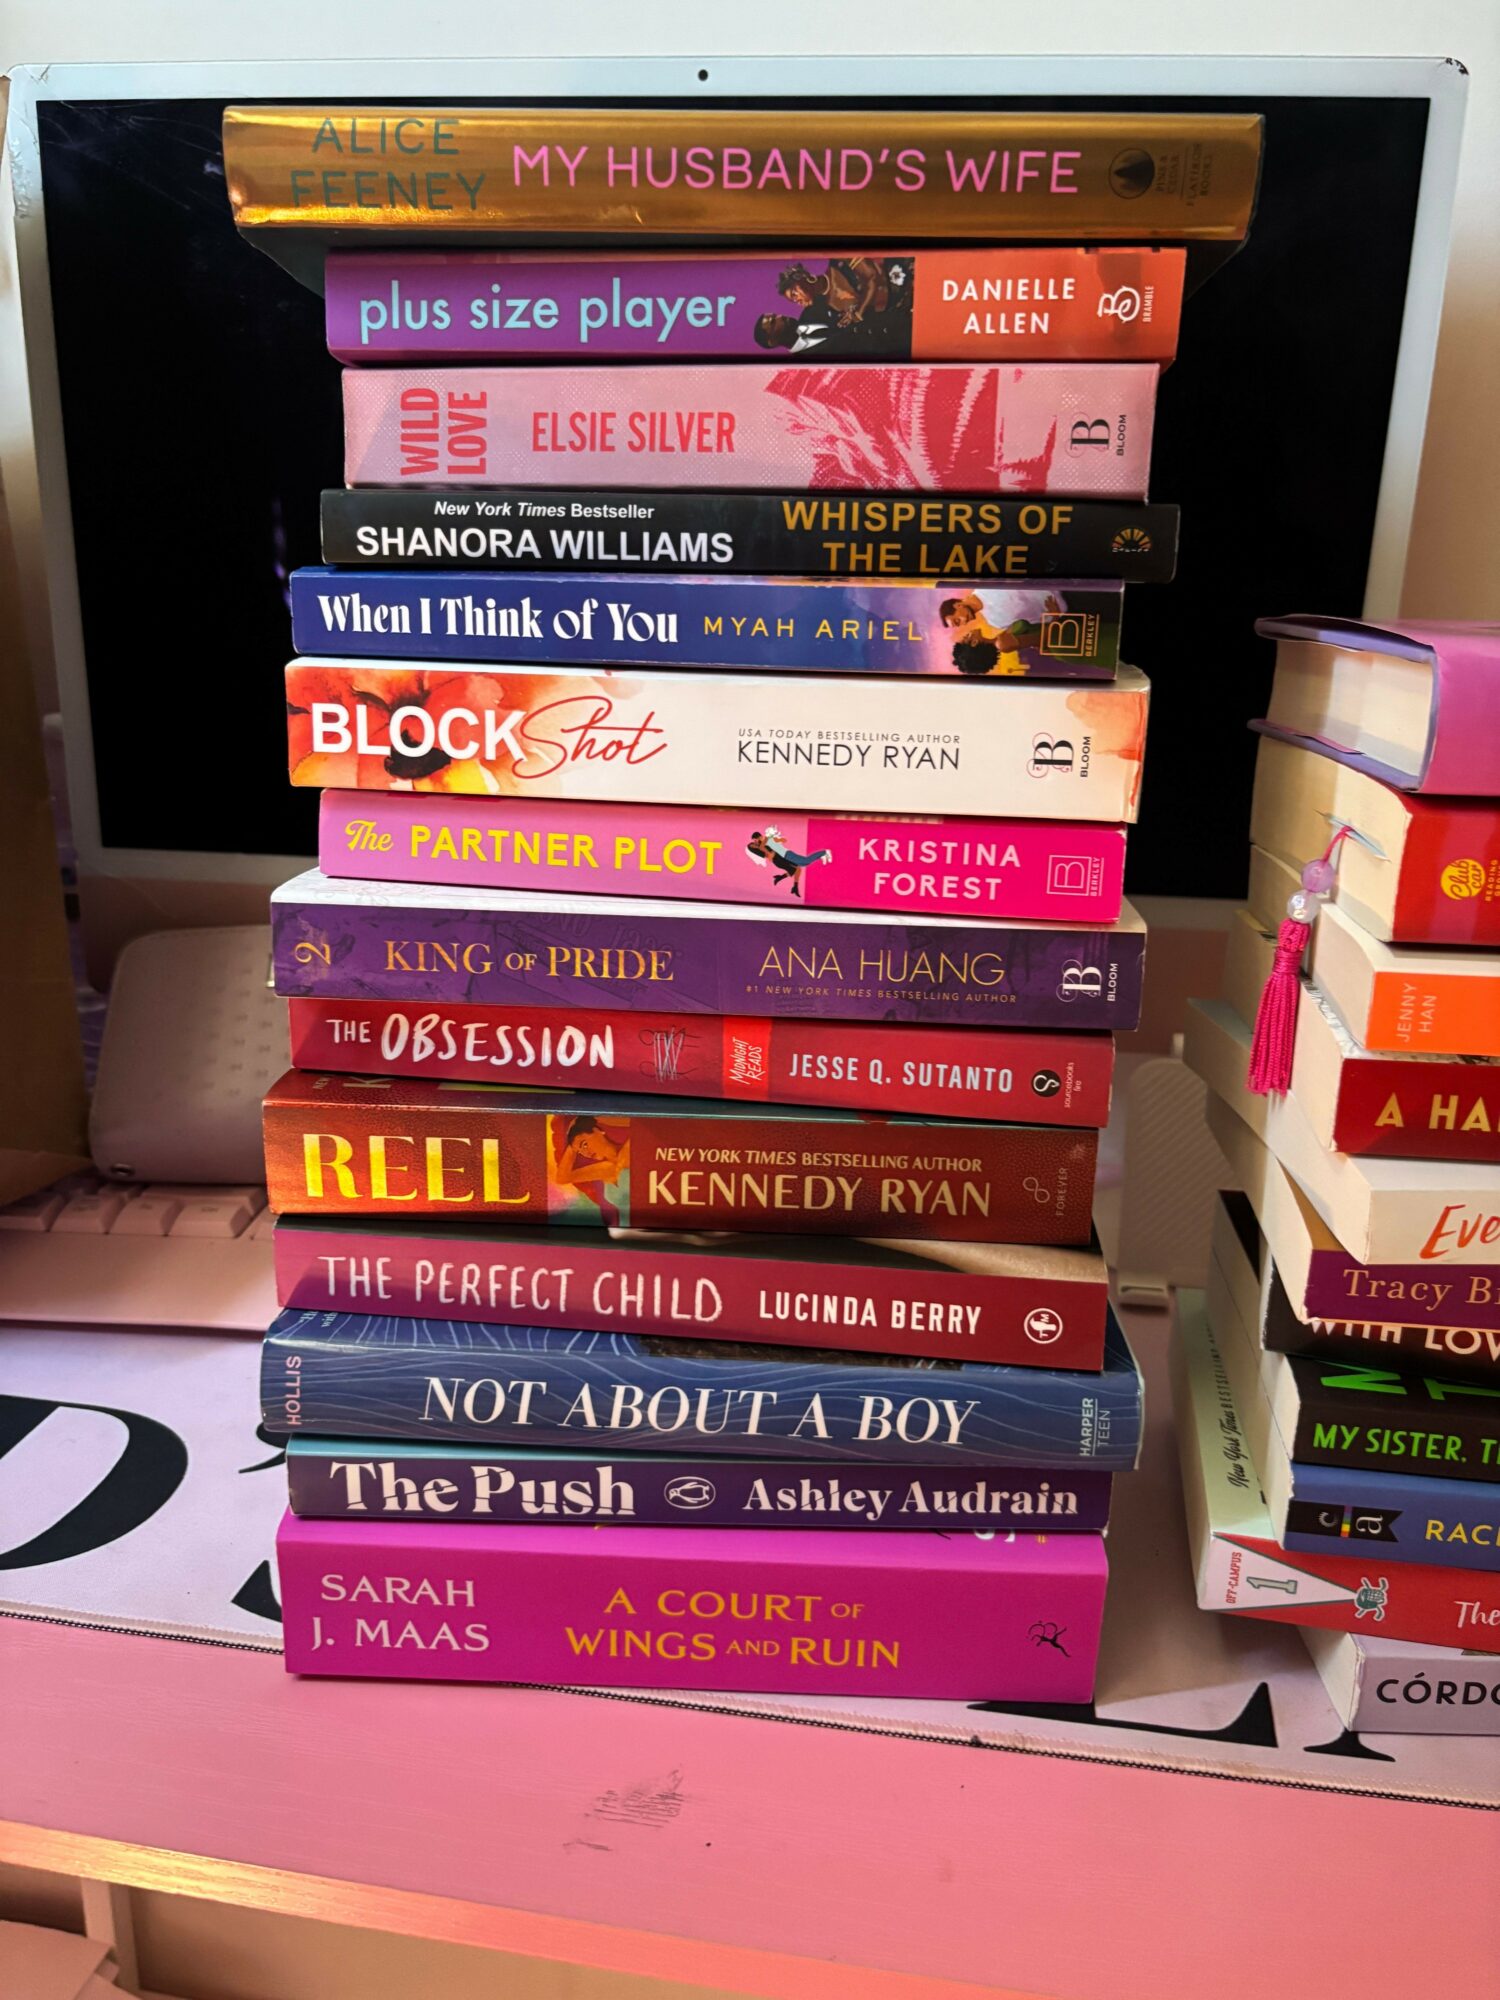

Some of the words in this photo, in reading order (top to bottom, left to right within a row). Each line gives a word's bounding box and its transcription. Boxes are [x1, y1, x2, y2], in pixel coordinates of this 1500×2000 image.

[312, 117, 462, 156] ALICE
[512, 145, 589, 187] MY
[606, 146, 927, 192] HUSBAND'S
[945, 149, 1083, 194] WIFE
[291, 170, 487, 211] FEENEY
[941, 278, 1076, 302] DANIELLE
[1142, 285, 1154, 323] BRAMBLE
[360, 279, 451, 346] plus
[469, 284, 559, 329] size
[579, 277, 737, 344] player
[963, 312, 1050, 335] ALLEN
[400, 387, 440, 476] WILD
[447, 391, 487, 475] LOVE
[532, 411, 617, 453] ELSIE
[627, 411, 737, 454] SILVER
[1116, 414, 1127, 457] BLOOM
[434, 500, 470, 517] New
[474, 501, 512, 518] York
[516, 502, 567, 518] Times
[570, 503, 655, 520] Bestseller
[781, 500, 1003, 535] WHISPERS
[1018, 504, 1074, 536] OF
[356, 526, 543, 560] SHANORA
[550, 529, 735, 564] WILLIAMS
[822, 542, 902, 573] THE
[920, 544, 1030, 575] LAKE
[317, 592, 412, 634] When
[419, 597, 433, 635] I
[440, 595, 544, 640] Think
[552, 598, 600, 641] of
[606, 602, 680, 644] You
[703, 615, 795, 639] MYAH
[815, 618, 924, 642] ARIEL
[1085, 613, 1097, 658] BERKLEY
[311, 701, 527, 762] BLOCK
[511, 695, 670, 780] Shot
[737, 740, 873, 769] KENNEDY
[882, 746, 961, 772] RYAN
[738, 728, 763, 738] USA
[767, 729, 812, 740] TODAY
[816, 731, 903, 743] BESTSELLING
[906, 733, 961, 745] AUTHOR
[1080, 736, 1092, 778] BLOOM
[344, 819, 395, 853] The
[410, 824, 600, 869] PARTNER
[613, 836, 723, 876] PLOT
[858, 837, 1022, 869] KRISTINA
[873, 872, 1003, 901] FOREST
[1090, 856, 1101, 897] BERKLEY
[383, 939, 494, 975] KING
[504, 951, 538, 972] OF
[545, 945, 676, 982] PRIDE
[758, 945, 845, 981] ANA
[858, 948, 1006, 986] HUANG
[745, 984, 760, 994] #1
[765, 984, 793, 995] NEW
[797, 985, 831, 998] YORK
[835, 987, 873, 999] TIMES
[877, 988, 960, 1002] BESTSELLING
[965, 991, 1018, 1004] AUTHOR
[1107, 962, 1118, 1002] BLOOM
[1397, 983, 1418, 1042] JENNY
[1419, 995, 1438, 1033] HAN
[326, 1018, 372, 1045] THE
[381, 1013, 615, 1070] OBSESSION
[729, 1036, 751, 1085] MIDNIGHT
[746, 1044, 764, 1082] READS
[788, 1053, 859, 1082] JESSE
[868, 1058, 893, 1086] Q.
[902, 1061, 1014, 1094] SUTANTO
[1064, 1062, 1075, 1109] sourcebooks
[1374, 1092, 1405, 1128] A
[1429, 1094, 1500, 1133] HA
[302, 1133, 531, 1205] REEL
[655, 1147, 696, 1164] NEW
[699, 1148, 741, 1165] YORK
[744, 1150, 797, 1166] TIMES
[801, 1152, 909, 1169] BESTSELLING
[911, 1155, 983, 1173] AUTHOR
[648, 1169, 864, 1213] KENNEDY
[879, 1178, 992, 1219] RYAN
[1055, 1167, 1069, 1216] FOREVER
[317, 1256, 393, 1300] THE
[414, 1259, 575, 1313] PERFECT
[592, 1271, 724, 1324] CHILD
[1343, 1269, 1453, 1312] Tracy
[758, 1289, 879, 1328] LUCINDA
[890, 1299, 983, 1336] BERRY
[285, 1355, 302, 1426] HOLLIS
[418, 1376, 548, 1426] NOT
[556, 1383, 779, 1436] ABOUT
[787, 1391, 834, 1440] A
[852, 1395, 982, 1445] BOY
[1079, 1397, 1095, 1458] HARPER
[1097, 1408, 1111, 1448] TEEN
[1217, 1409, 1242, 1436] Times
[1313, 1423, 1360, 1450] MY
[1223, 1437, 1249, 1462] York
[329, 1462, 460, 1513] The
[470, 1465, 637, 1517] Push
[1227, 1456, 1250, 1488] New
[742, 1478, 894, 1522] Ashley
[898, 1480, 1080, 1517] Audrain
[1424, 1519, 1500, 1548] RAC
[321, 1574, 477, 1608] SARAH
[1225, 1552, 1242, 1604] OFF-CAMPUS
[604, 1587, 638, 1616] A
[657, 1590, 822, 1623] COURT
[830, 1602, 865, 1619] OF
[311, 1616, 336, 1651] J.
[355, 1618, 490, 1653] MAAS
[564, 1626, 717, 1661] WINGS
[725, 1638, 781, 1658] AND
[789, 1635, 900, 1669] RUIN
